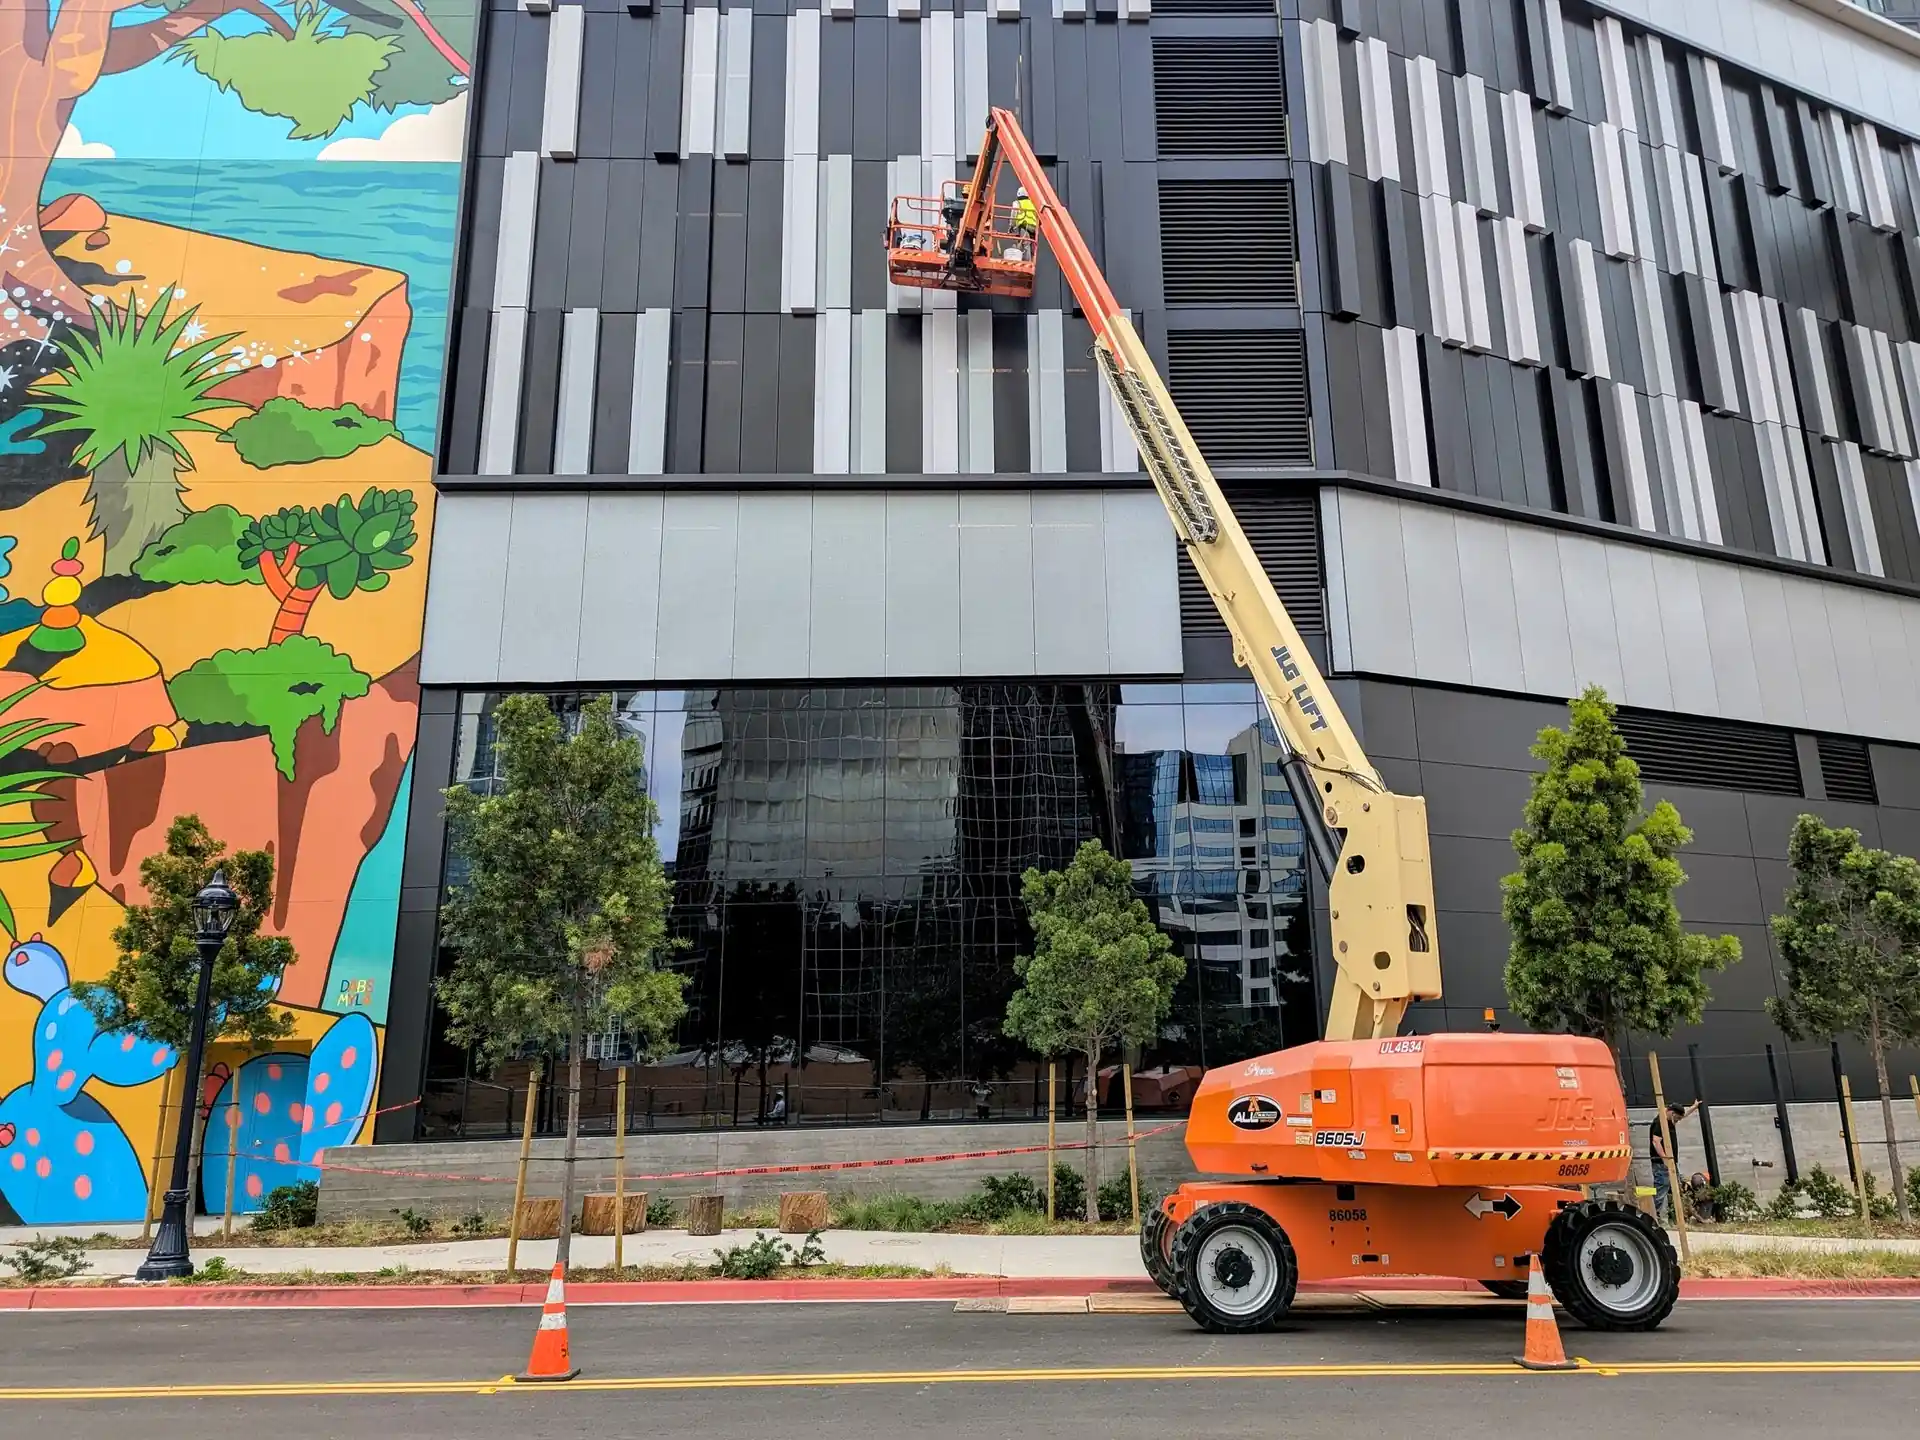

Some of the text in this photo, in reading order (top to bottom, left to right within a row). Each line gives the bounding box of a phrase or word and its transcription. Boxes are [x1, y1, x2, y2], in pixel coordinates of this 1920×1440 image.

[1270, 645, 1328, 731] JLG LIFT
[1380, 1040, 1422, 1054] UL4B34
[1232, 1111, 1259, 1123] ALL
[1535, 1097, 1594, 1132] JLG
[1558, 1163, 1591, 1177] 86058
[1328, 1208, 1368, 1222] 86058
